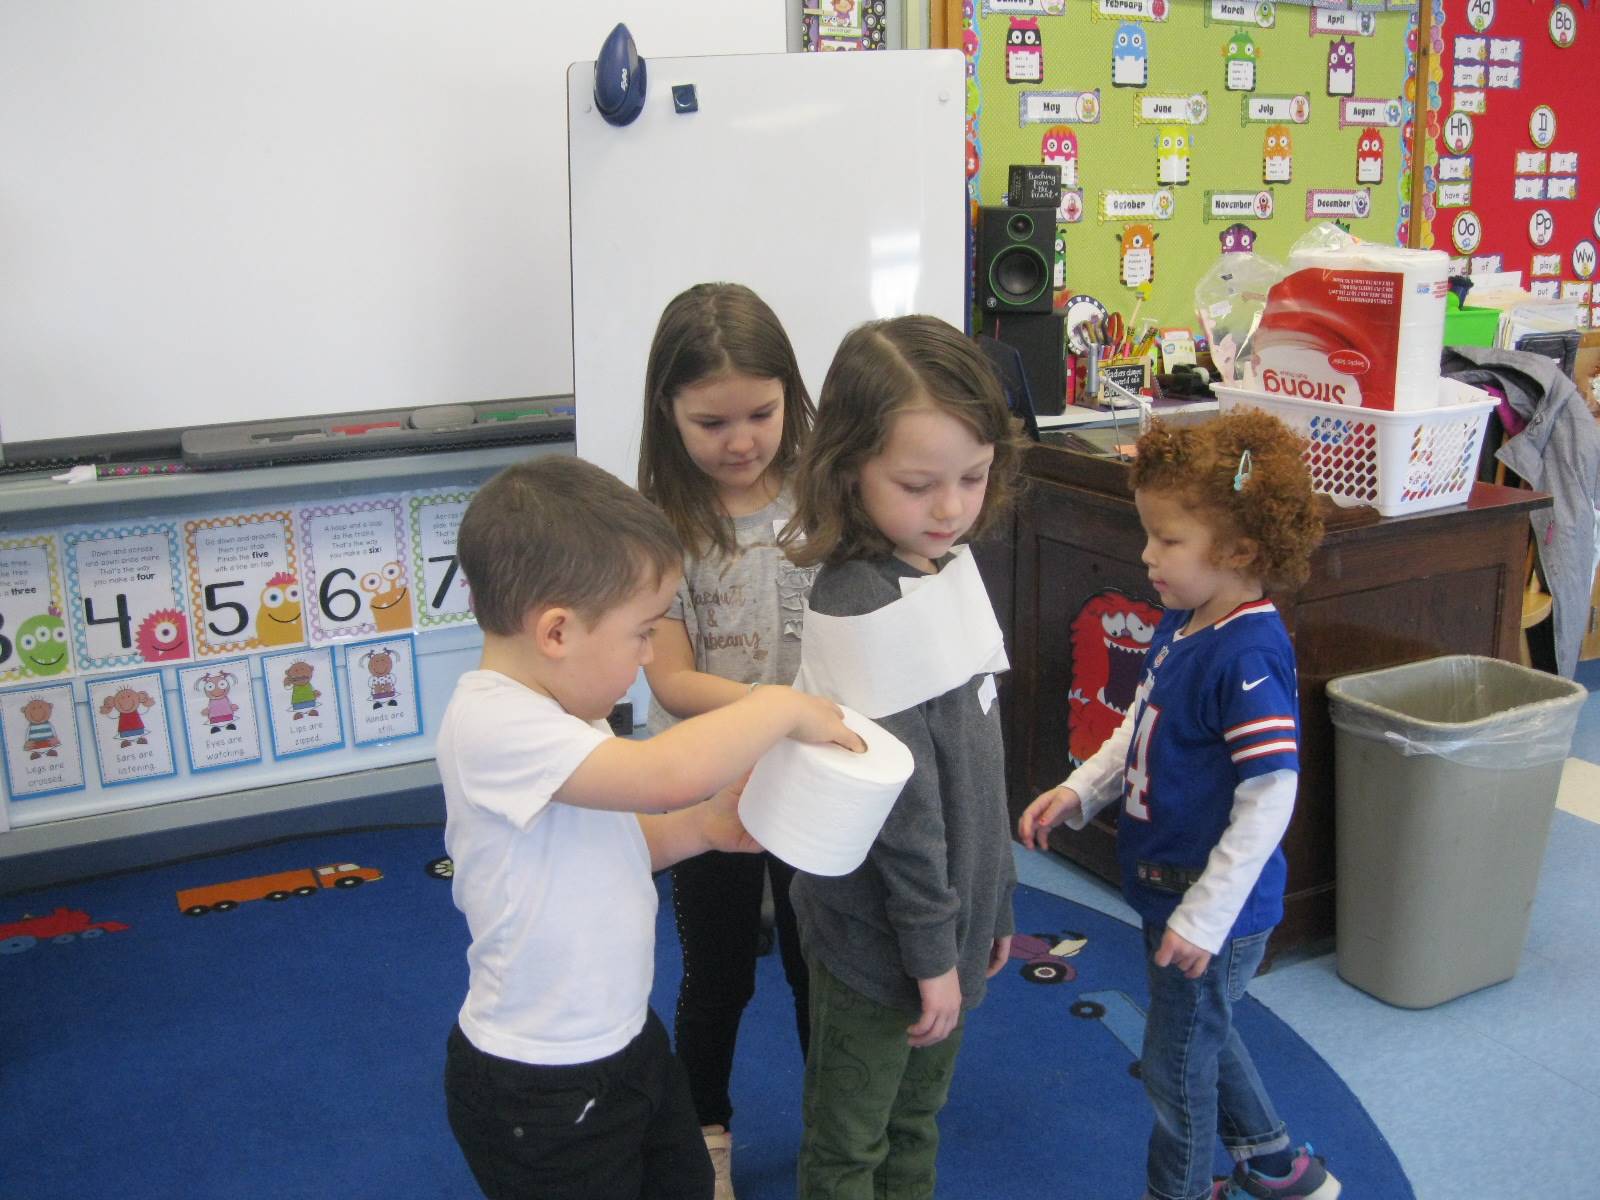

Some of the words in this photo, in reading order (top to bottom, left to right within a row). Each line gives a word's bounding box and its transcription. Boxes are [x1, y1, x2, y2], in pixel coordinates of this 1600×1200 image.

[1105, 0, 1143, 11] February
[1220, 4, 1245, 15] March
[1471, 0, 1491, 15] Aa
[1327, 15, 1345, 25] April
[1555, 11, 1572, 31] Bb
[1462, 73, 1473, 81] am
[1496, 73, 1508, 82] and
[1043, 101, 1061, 114] May
[1153, 103, 1172, 113] June
[1258, 104, 1274, 115] July
[1353, 107, 1376, 117] August
[1450, 118, 1469, 137] Hh
[1028, 170, 1056, 184] teaching
[1033, 179, 1049, 190] from
[1031, 190, 1054, 199] heart
[1444, 190, 1460, 200] have
[1113, 198, 1146, 209] October
[1215, 200, 1252, 209] November
[1317, 198, 1350, 208] December
[1457, 218, 1476, 236] Oo
[1535, 213, 1552, 236] Pp
[1576, 249, 1594, 264] Ww
[1540, 261, 1552, 271] play
[1537, 288, 1548, 296] put
[1263, 369, 1346, 404] Strong
[252, 551, 269, 559] five
[428, 554, 459, 609] 7
[11, 586, 37, 596] three
[318, 567, 362, 622] 6
[204, 580, 249, 637] 5
[84, 593, 132, 649] 4
[391, 711, 405, 719] are
[290, 725, 308, 734] Lips
[309, 722, 323, 730] are
[206, 738, 226, 749] Eyes
[227, 736, 242, 744] are
[138, 749, 153, 759] are
[25, 765, 47, 774] Legs
[49, 762, 65, 770] are
[1125, 703, 1162, 823] 4
